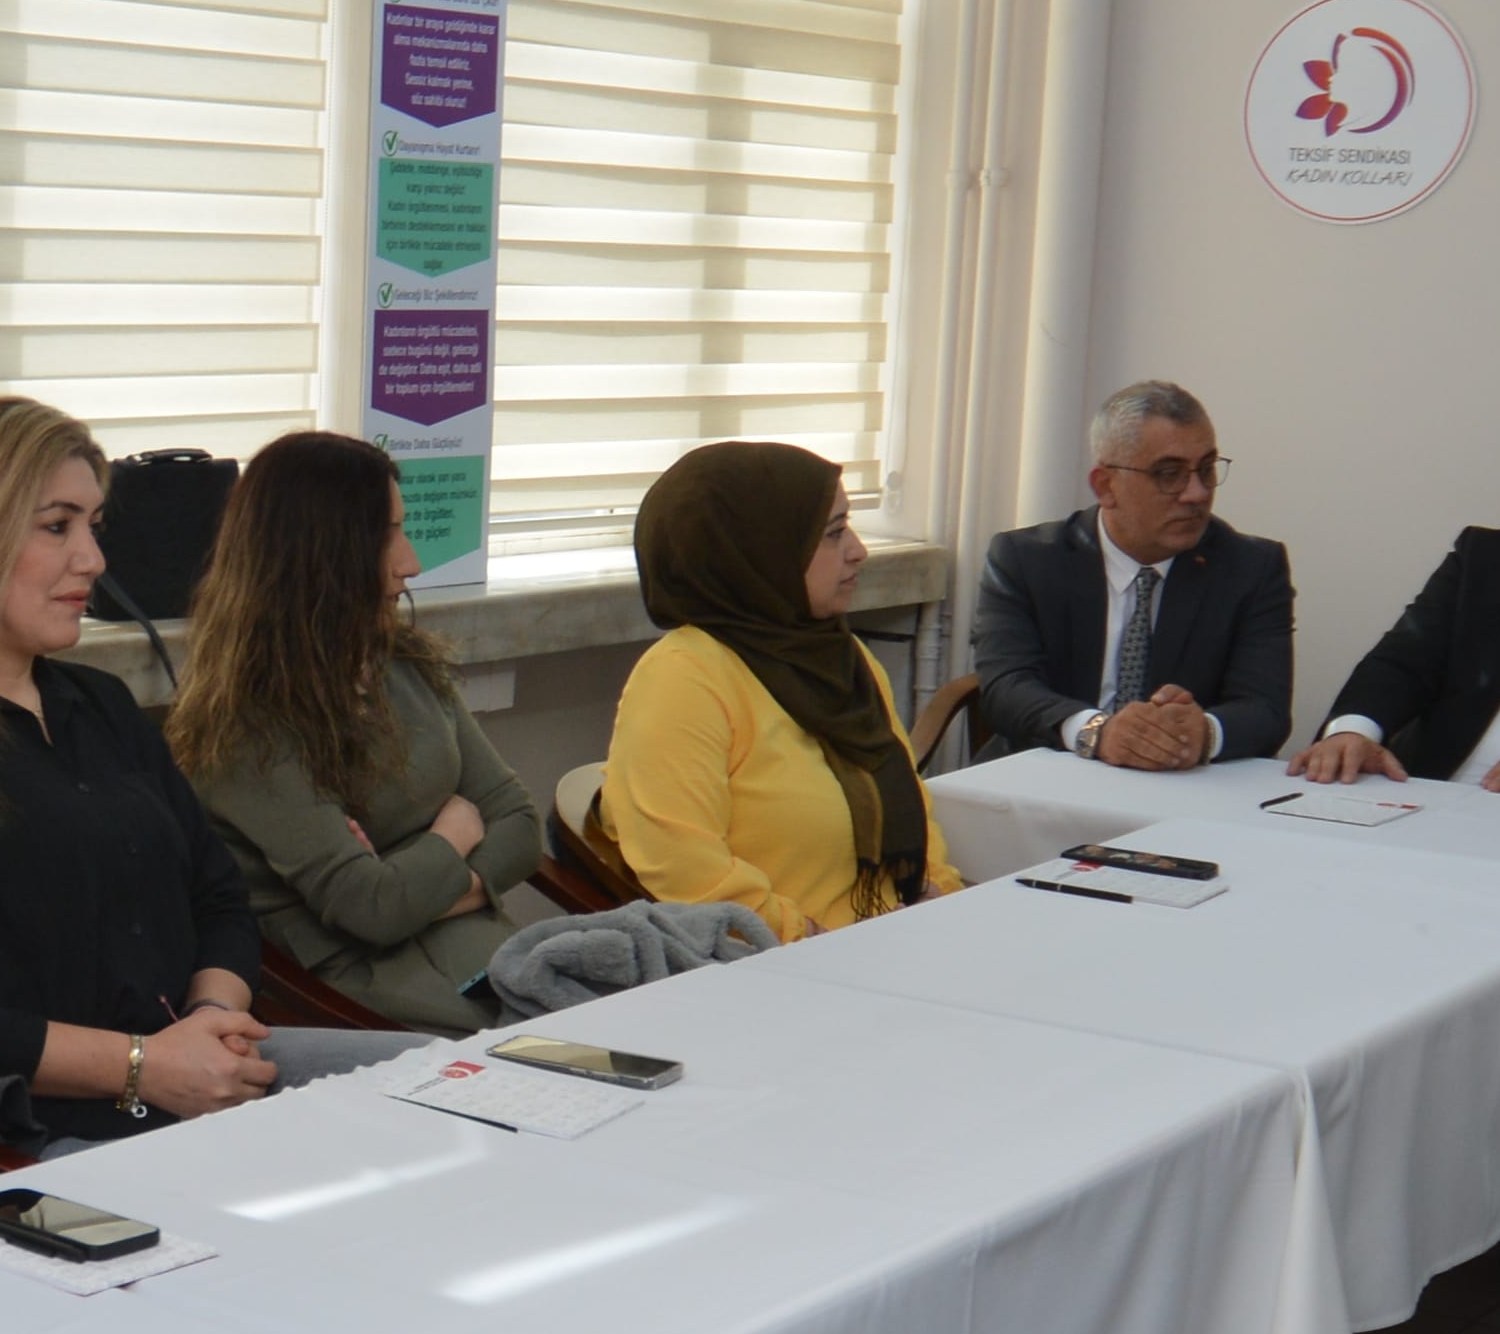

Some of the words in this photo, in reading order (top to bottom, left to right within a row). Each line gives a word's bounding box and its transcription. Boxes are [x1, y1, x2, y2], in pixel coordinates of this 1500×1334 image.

[1336, 145, 1411, 166] SENDİKASI
[1285, 168, 1338, 185] KADIN
[1340, 169, 1412, 187] KOLLARI
